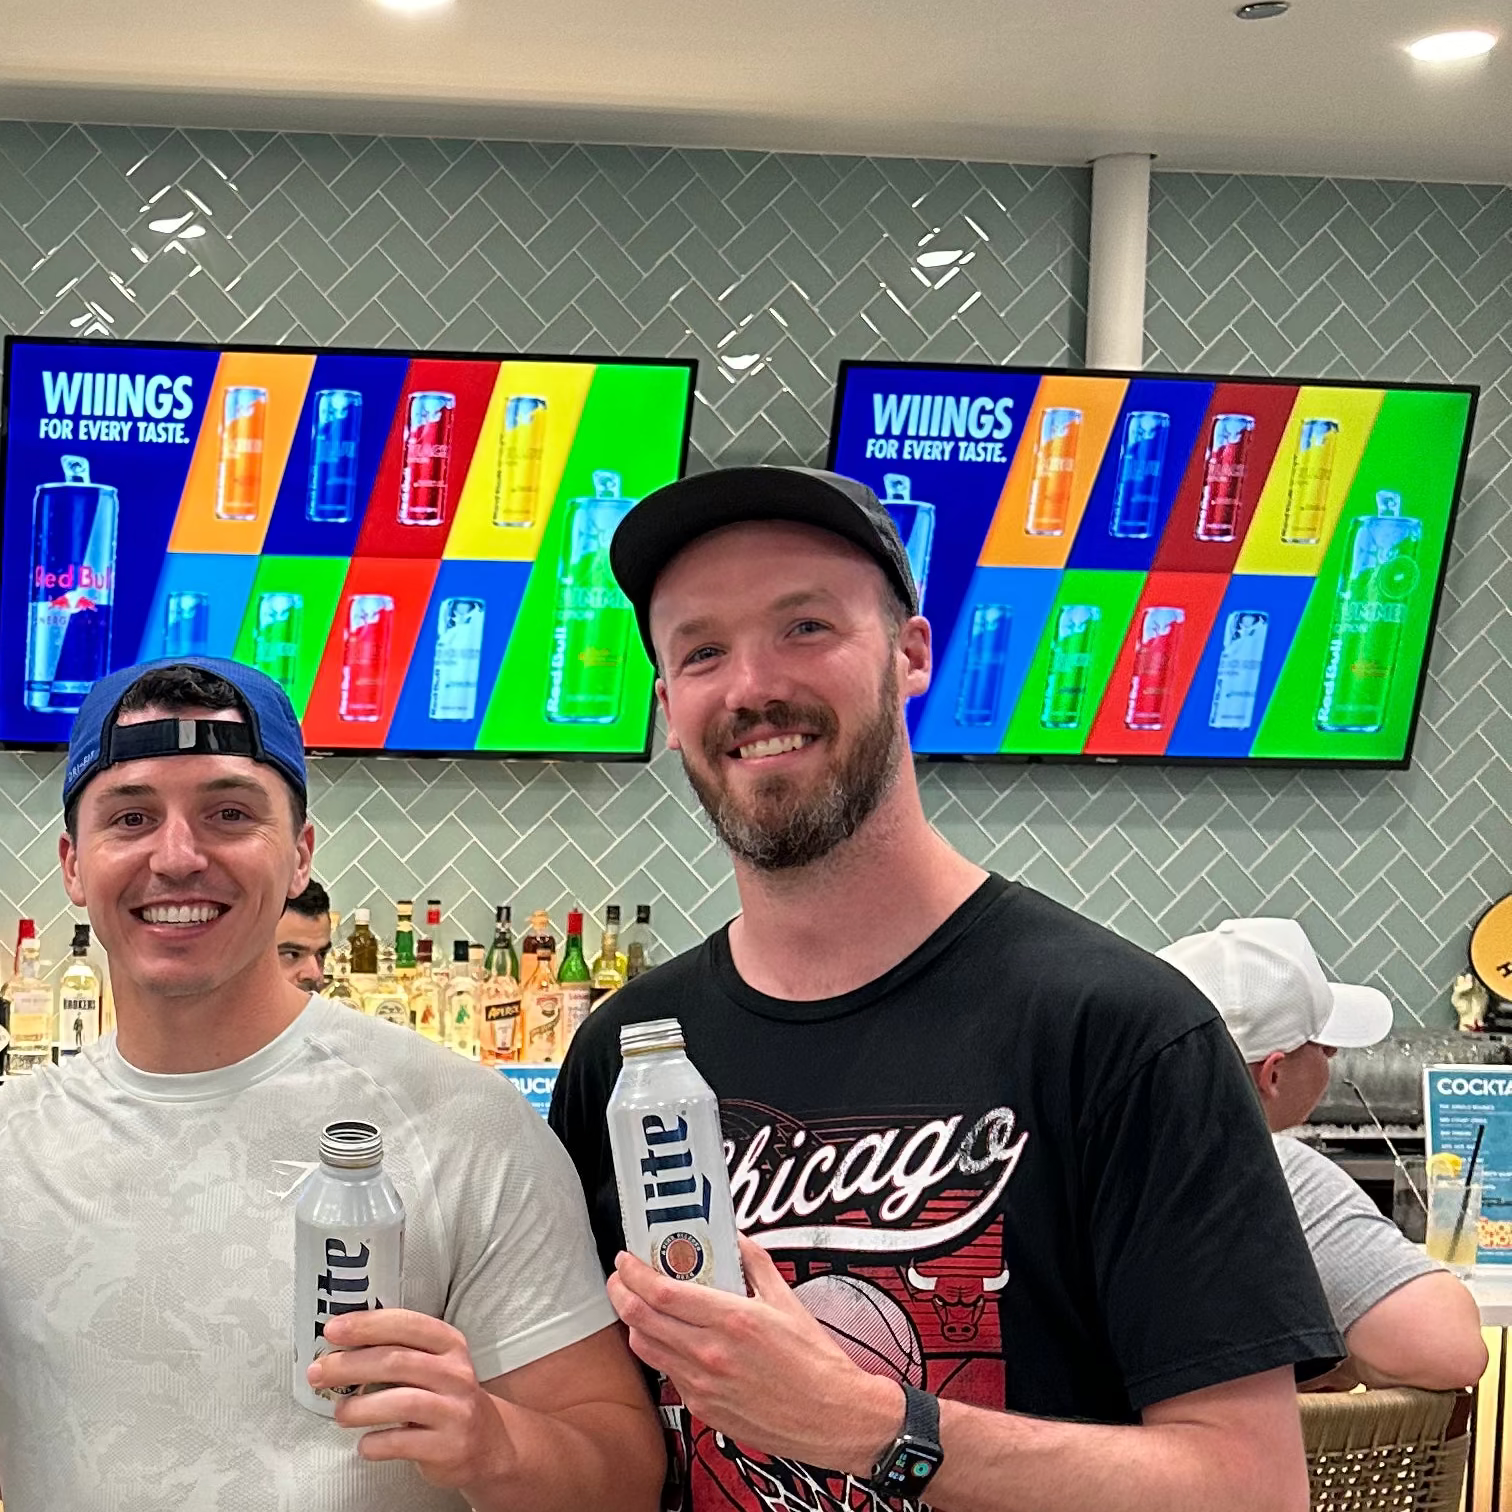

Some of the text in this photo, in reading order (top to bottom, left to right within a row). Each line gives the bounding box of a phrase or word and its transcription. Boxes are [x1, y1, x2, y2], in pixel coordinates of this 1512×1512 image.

[42, 371, 193, 420] WIIINGS
[873, 393, 1014, 440] WIIINGS
[39, 418, 190, 444] FOR EVERY TASTE.
[865, 438, 1007, 463] FOR EVERY TASTE.
[640, 1114, 711, 1232] Lite
[721, 1107, 1029, 1232] hicago
[314, 1237, 383, 1341] ite
